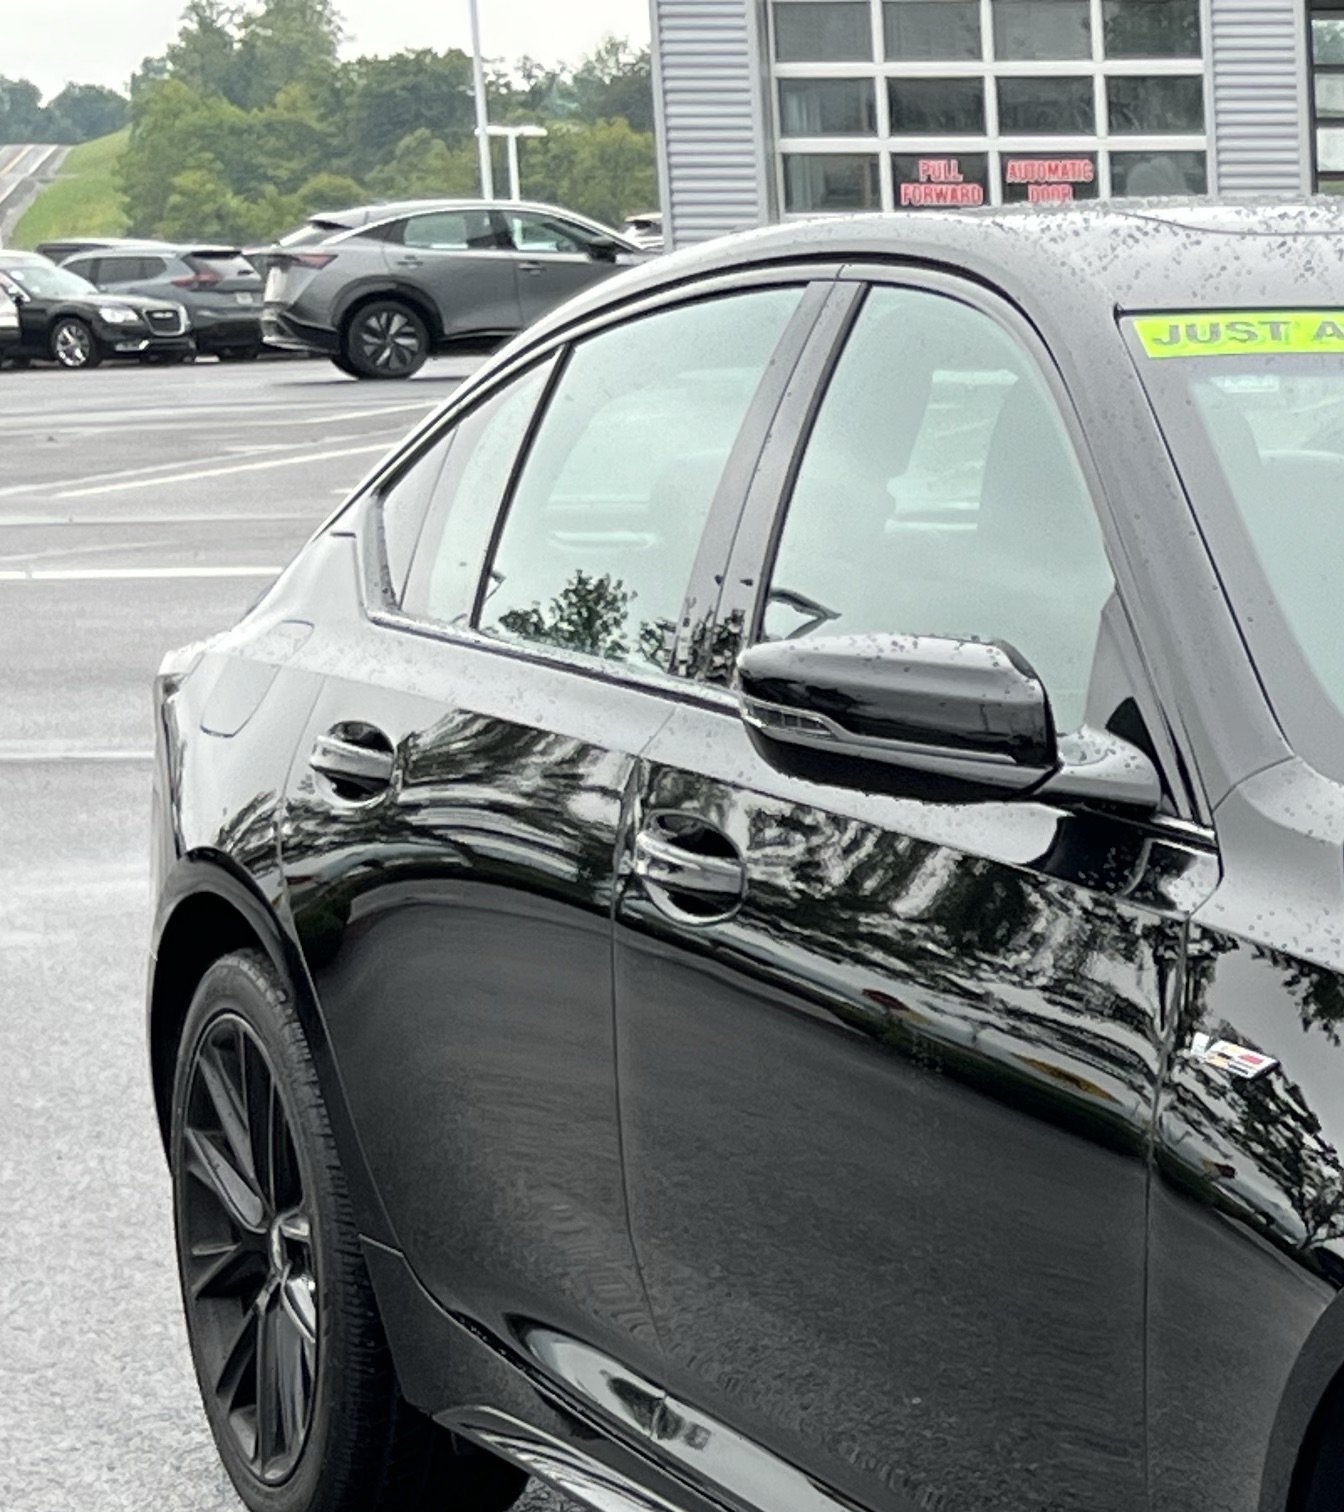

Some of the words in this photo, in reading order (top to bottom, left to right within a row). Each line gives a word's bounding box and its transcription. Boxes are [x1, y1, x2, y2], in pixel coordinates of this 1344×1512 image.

[918, 159, 963, 182] PULL
[1006, 158, 1094, 182] AUTOMATIC
[901, 183, 983, 206] FORWARD
[1153, 320, 1291, 347] JUST
